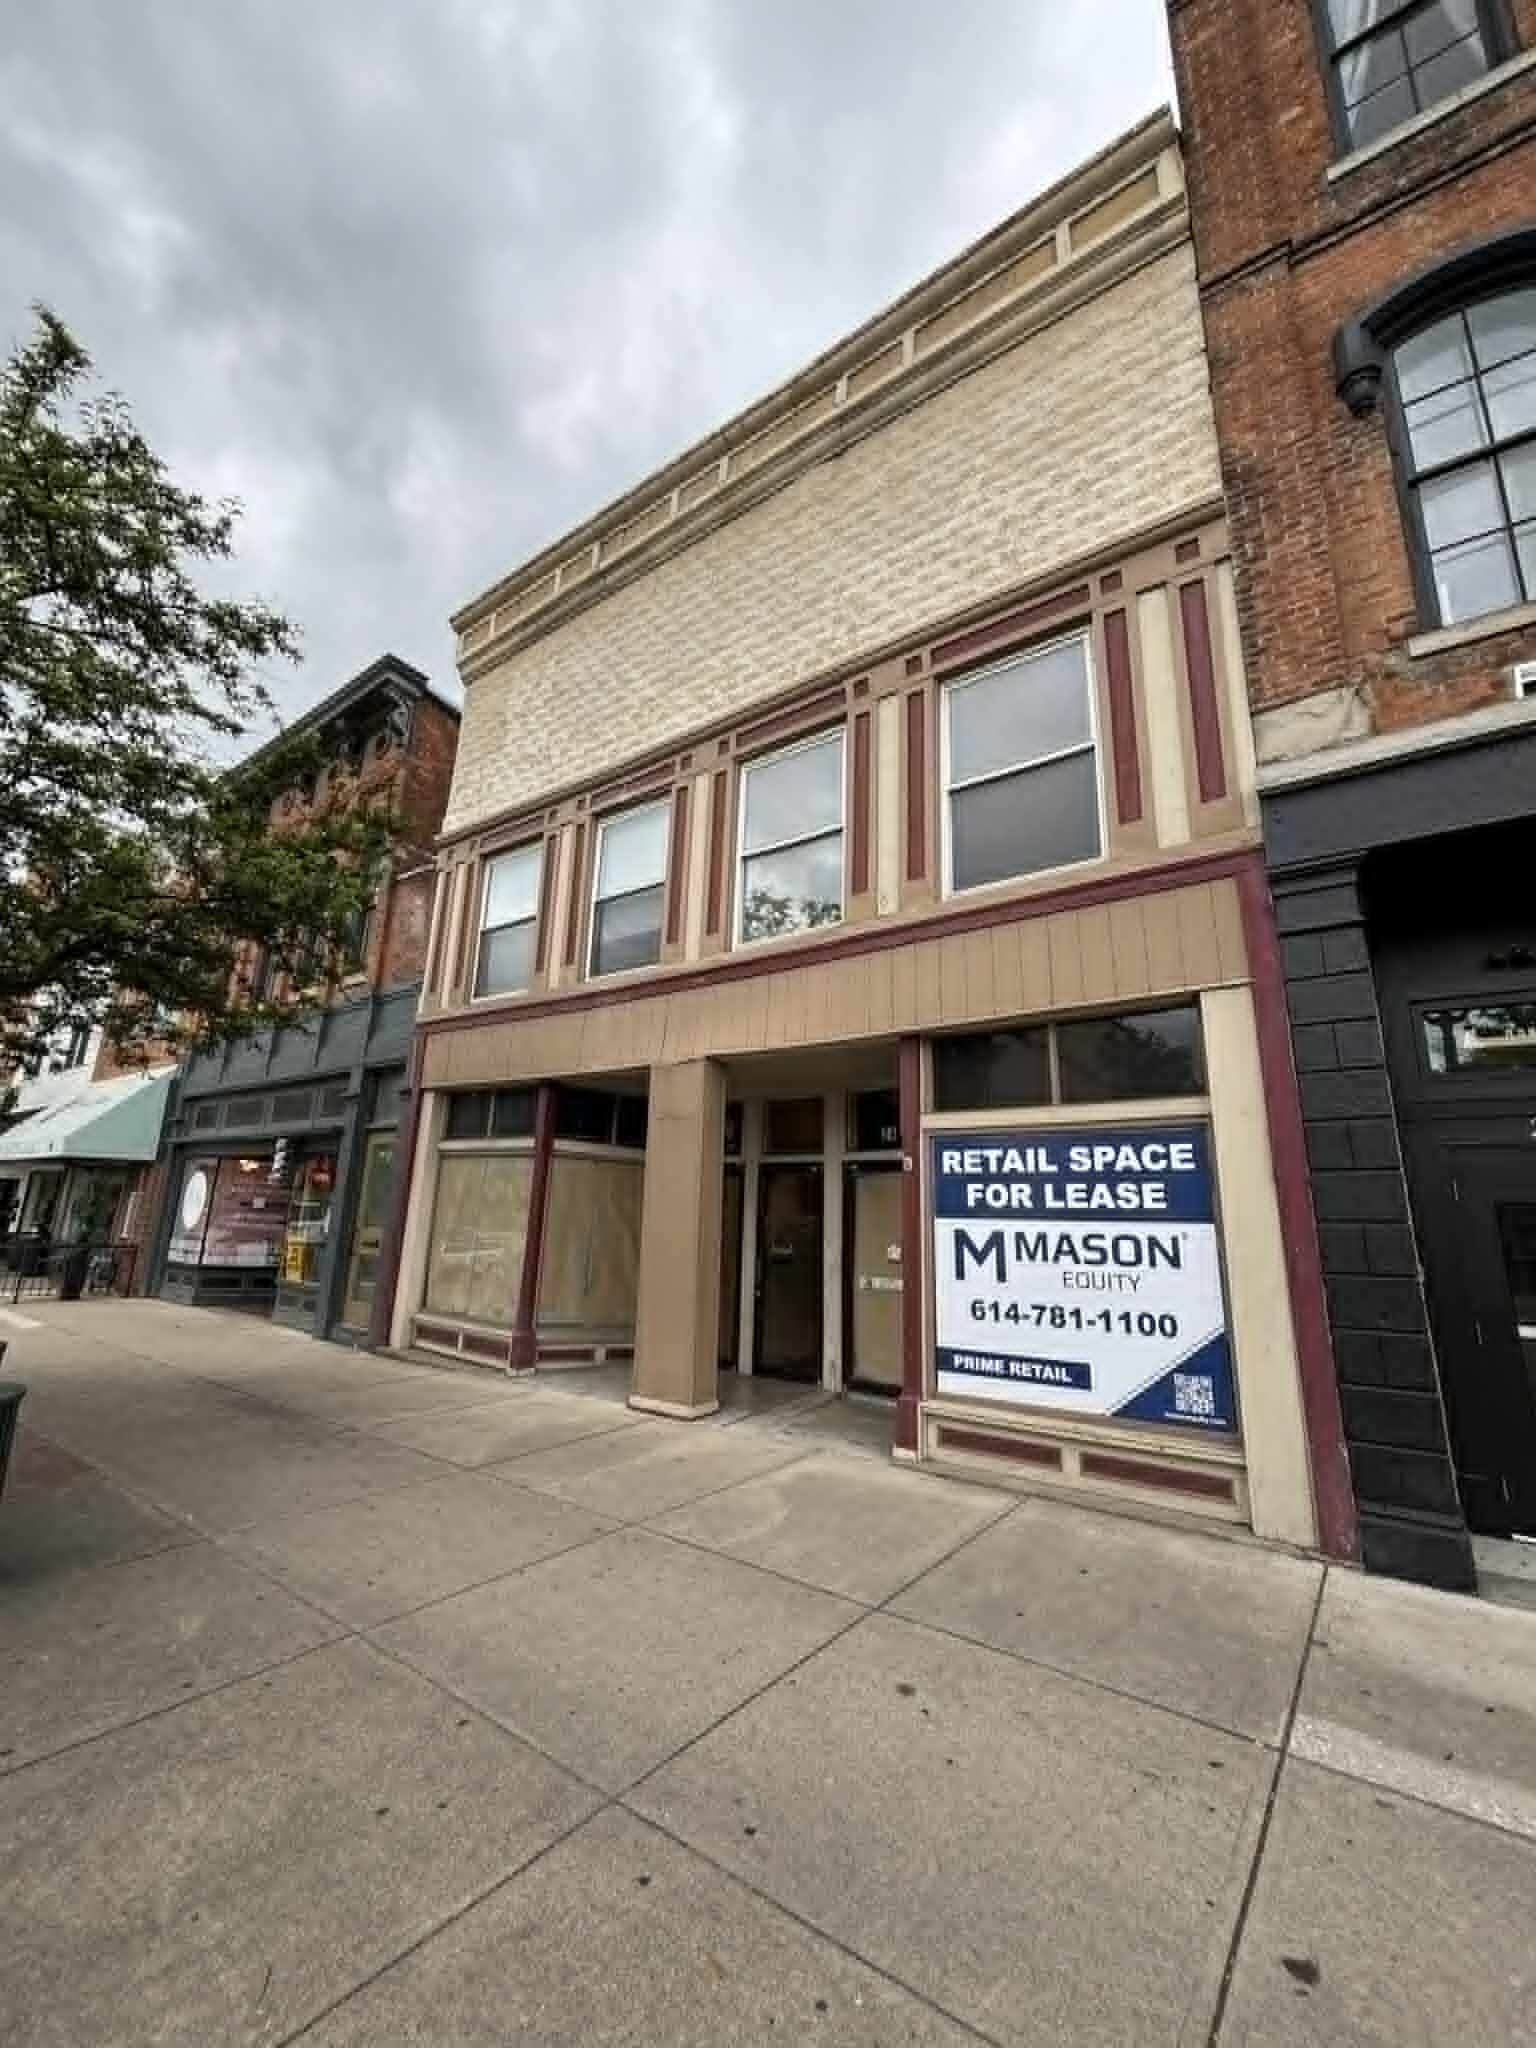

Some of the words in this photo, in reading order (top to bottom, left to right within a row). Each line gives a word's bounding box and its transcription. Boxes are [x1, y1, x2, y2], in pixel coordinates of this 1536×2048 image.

[943, 1147, 1058, 1174] RETAIL
[1069, 1143, 1196, 1171] SPACE
[967, 1183, 1034, 1208] FOR
[1045, 1183, 1167, 1209] LEASE
[1014, 1231, 1182, 1269] MASON
[1063, 1271, 1142, 1293] EQUITY
[970, 1299, 1178, 1338] 614-781-1100
[953, 1354, 1005, 1372] PRIME
[1009, 1359, 1073, 1383] RETAIL
